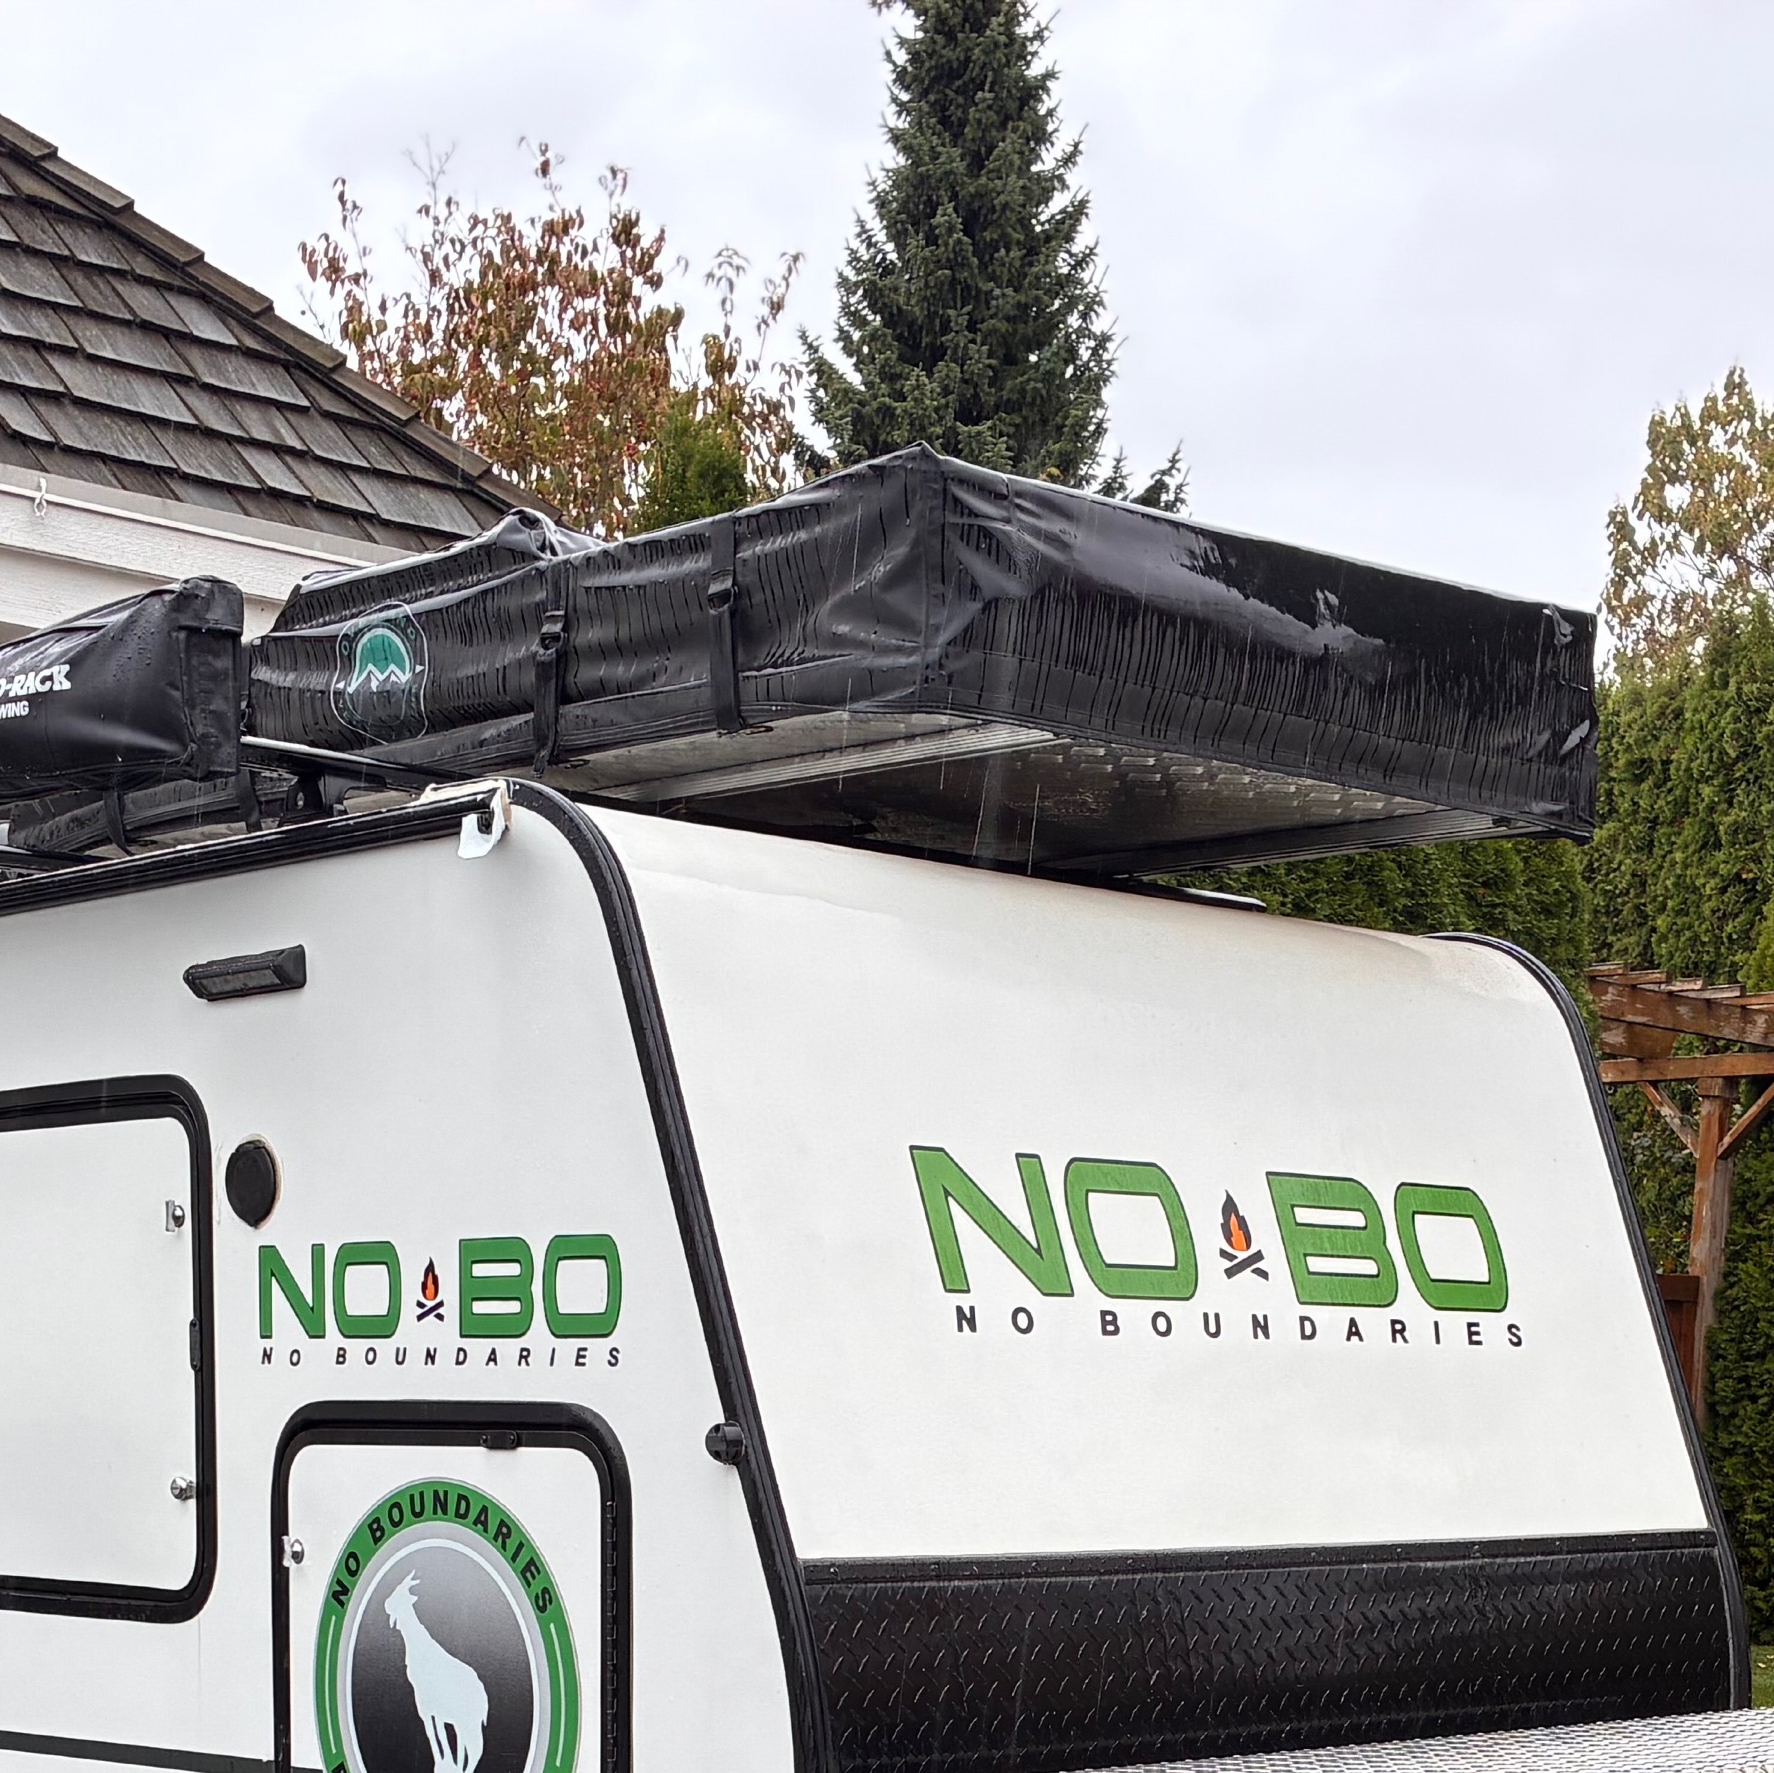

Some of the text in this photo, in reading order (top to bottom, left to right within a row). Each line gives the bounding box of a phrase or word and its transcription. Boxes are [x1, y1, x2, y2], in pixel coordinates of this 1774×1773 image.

[955, 1305, 1523, 1348] NO BOUNDARIES
[261, 1346, 621, 1368] NO BOUNDARIES
[331, 1489, 553, 1616] NO BOUNDARIES
